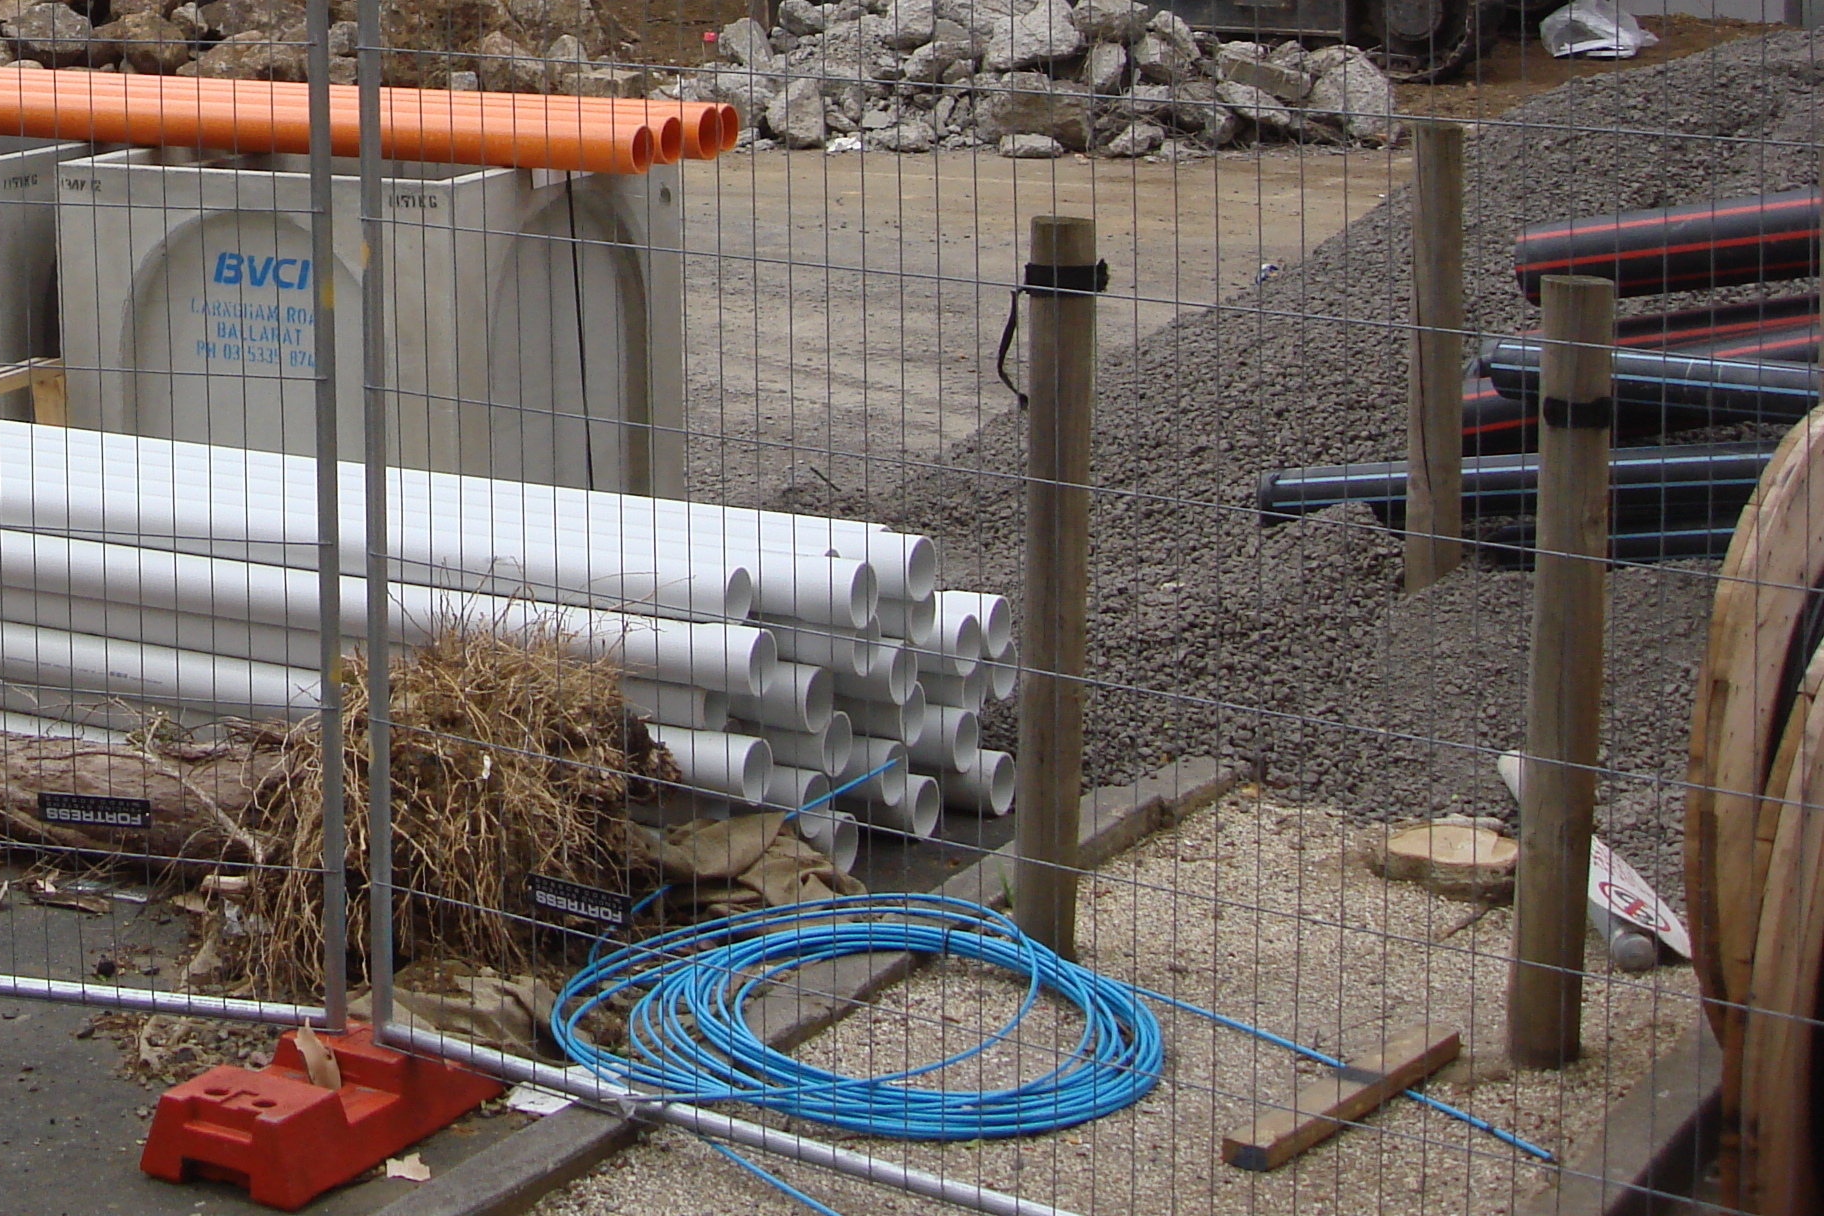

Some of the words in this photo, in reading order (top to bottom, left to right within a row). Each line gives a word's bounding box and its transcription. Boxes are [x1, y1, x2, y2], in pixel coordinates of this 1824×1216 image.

[213, 251, 311, 290] BVCI
[217, 321, 302, 346] BALLARAT
[196, 339, 216, 359] PH
[223, 343, 241, 361] 03
[46, 807, 142, 825] FORTRESS
[536, 890, 622, 923] FORTRESS
